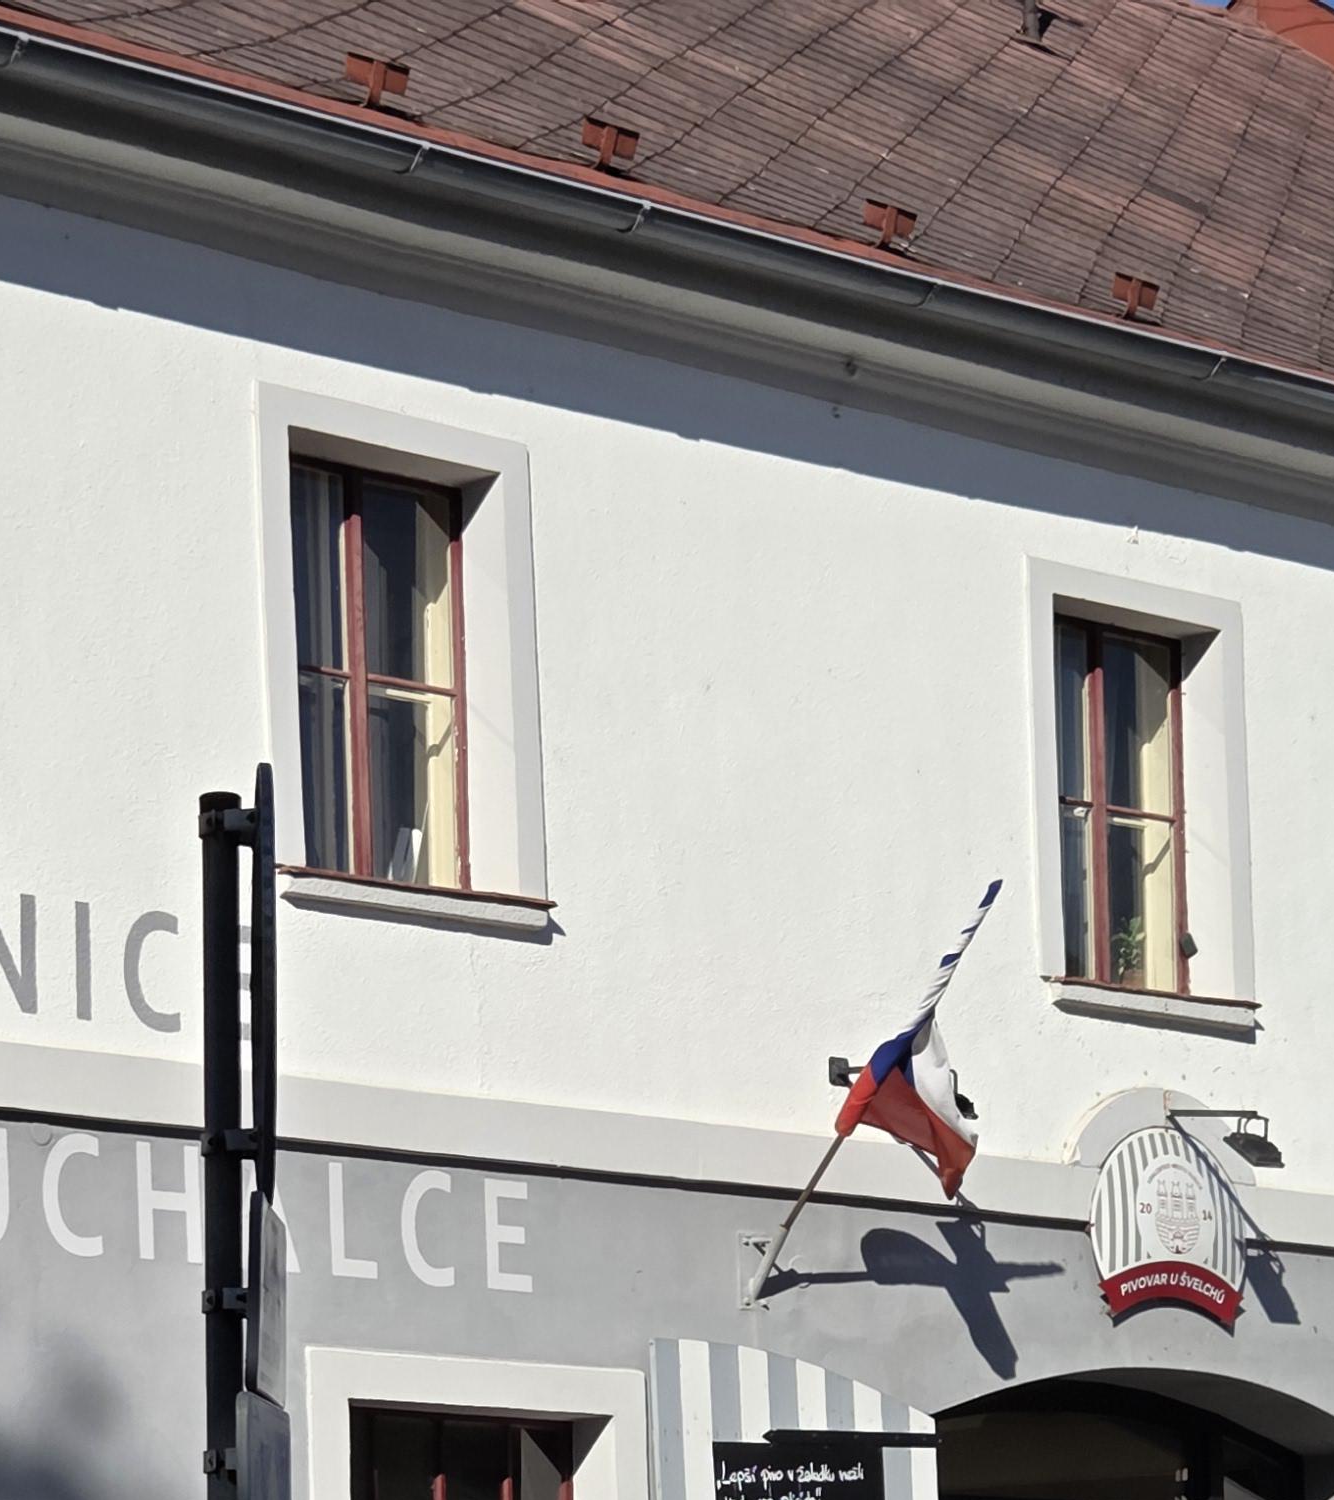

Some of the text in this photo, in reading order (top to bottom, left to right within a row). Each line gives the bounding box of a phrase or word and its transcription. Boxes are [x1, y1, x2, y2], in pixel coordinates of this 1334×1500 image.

[1140, 1203, 1152, 1214] 20
[1120, 1271, 1168, 1297] PIVOVAR
[1170, 1271, 1177, 1285] U
[787, 1470, 795, 1479] v
